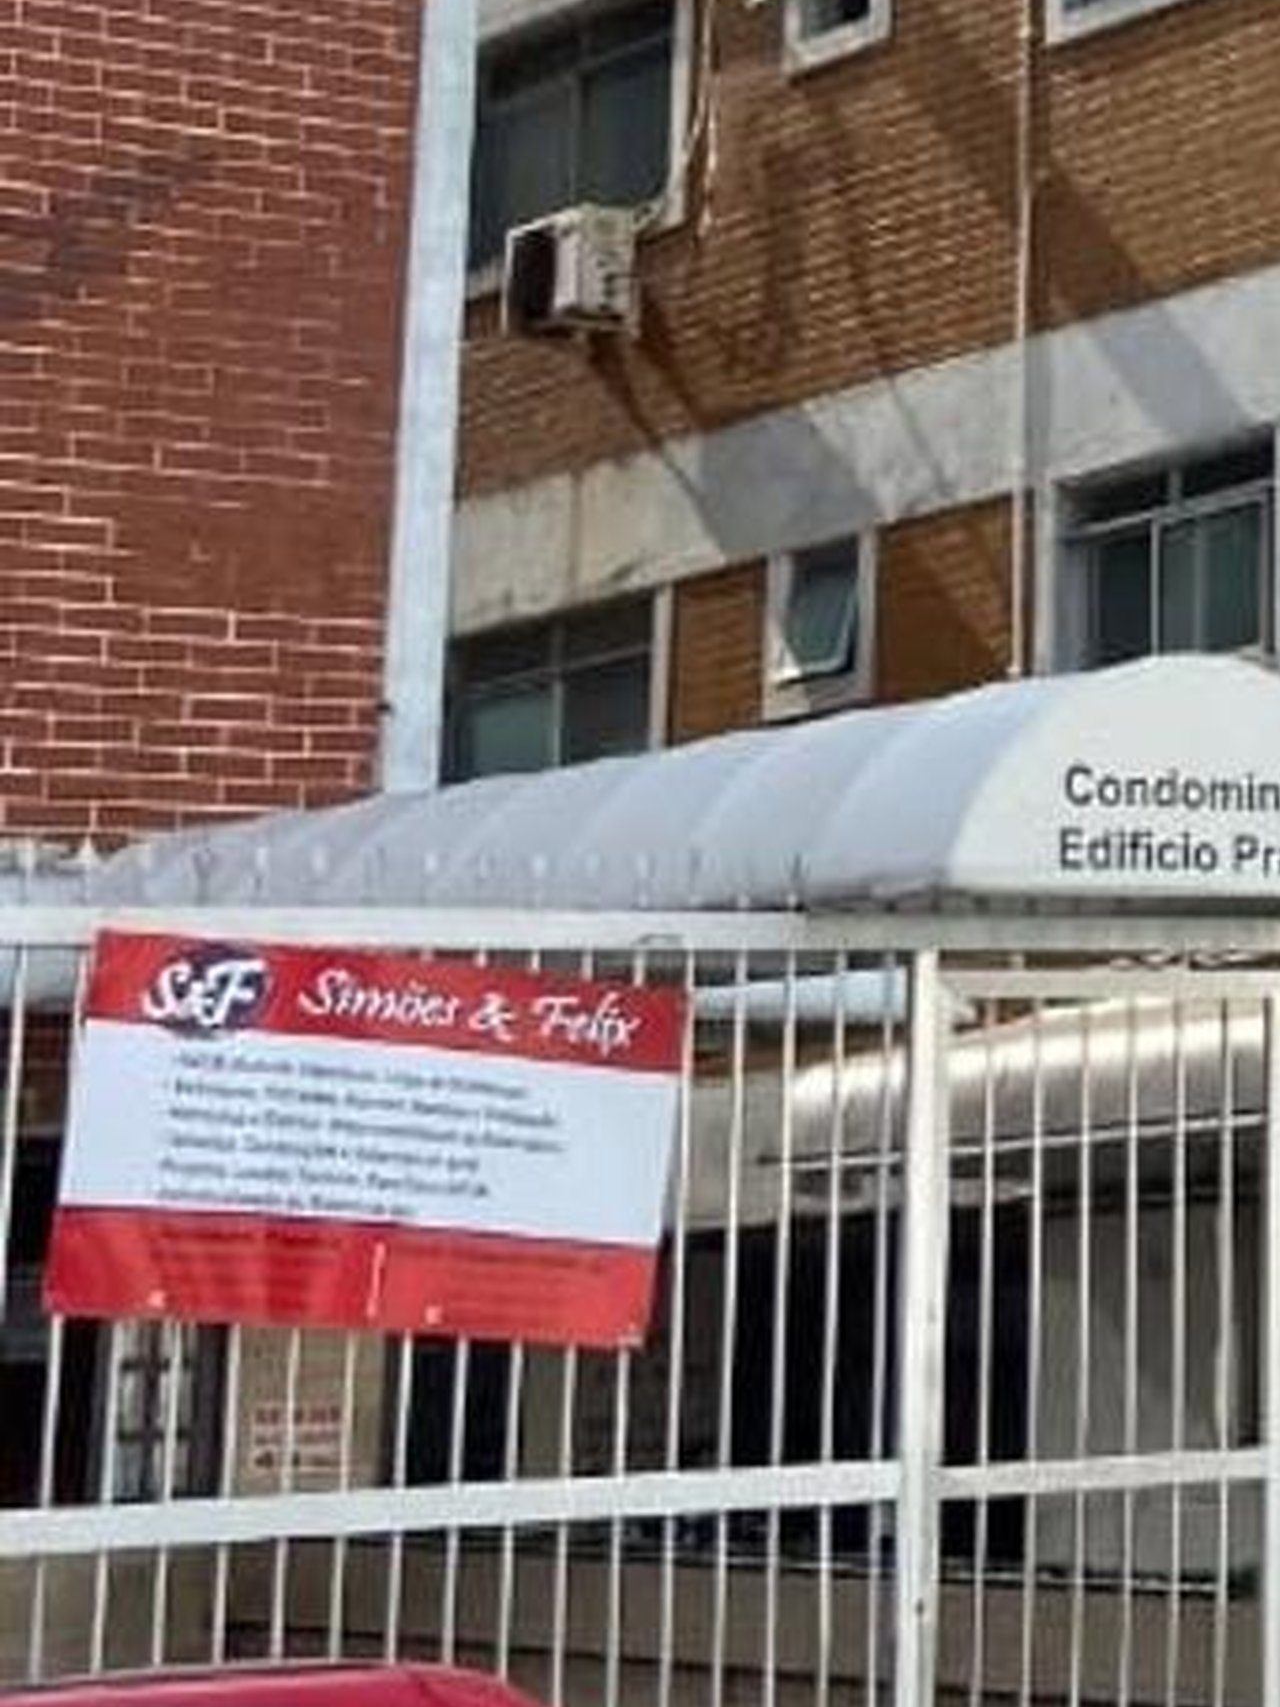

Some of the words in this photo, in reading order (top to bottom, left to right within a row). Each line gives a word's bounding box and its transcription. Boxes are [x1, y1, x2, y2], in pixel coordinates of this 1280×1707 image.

[299, 968, 459, 1030] Simões
[467, 992, 516, 1042] &
[530, 991, 643, 1058] Felix
